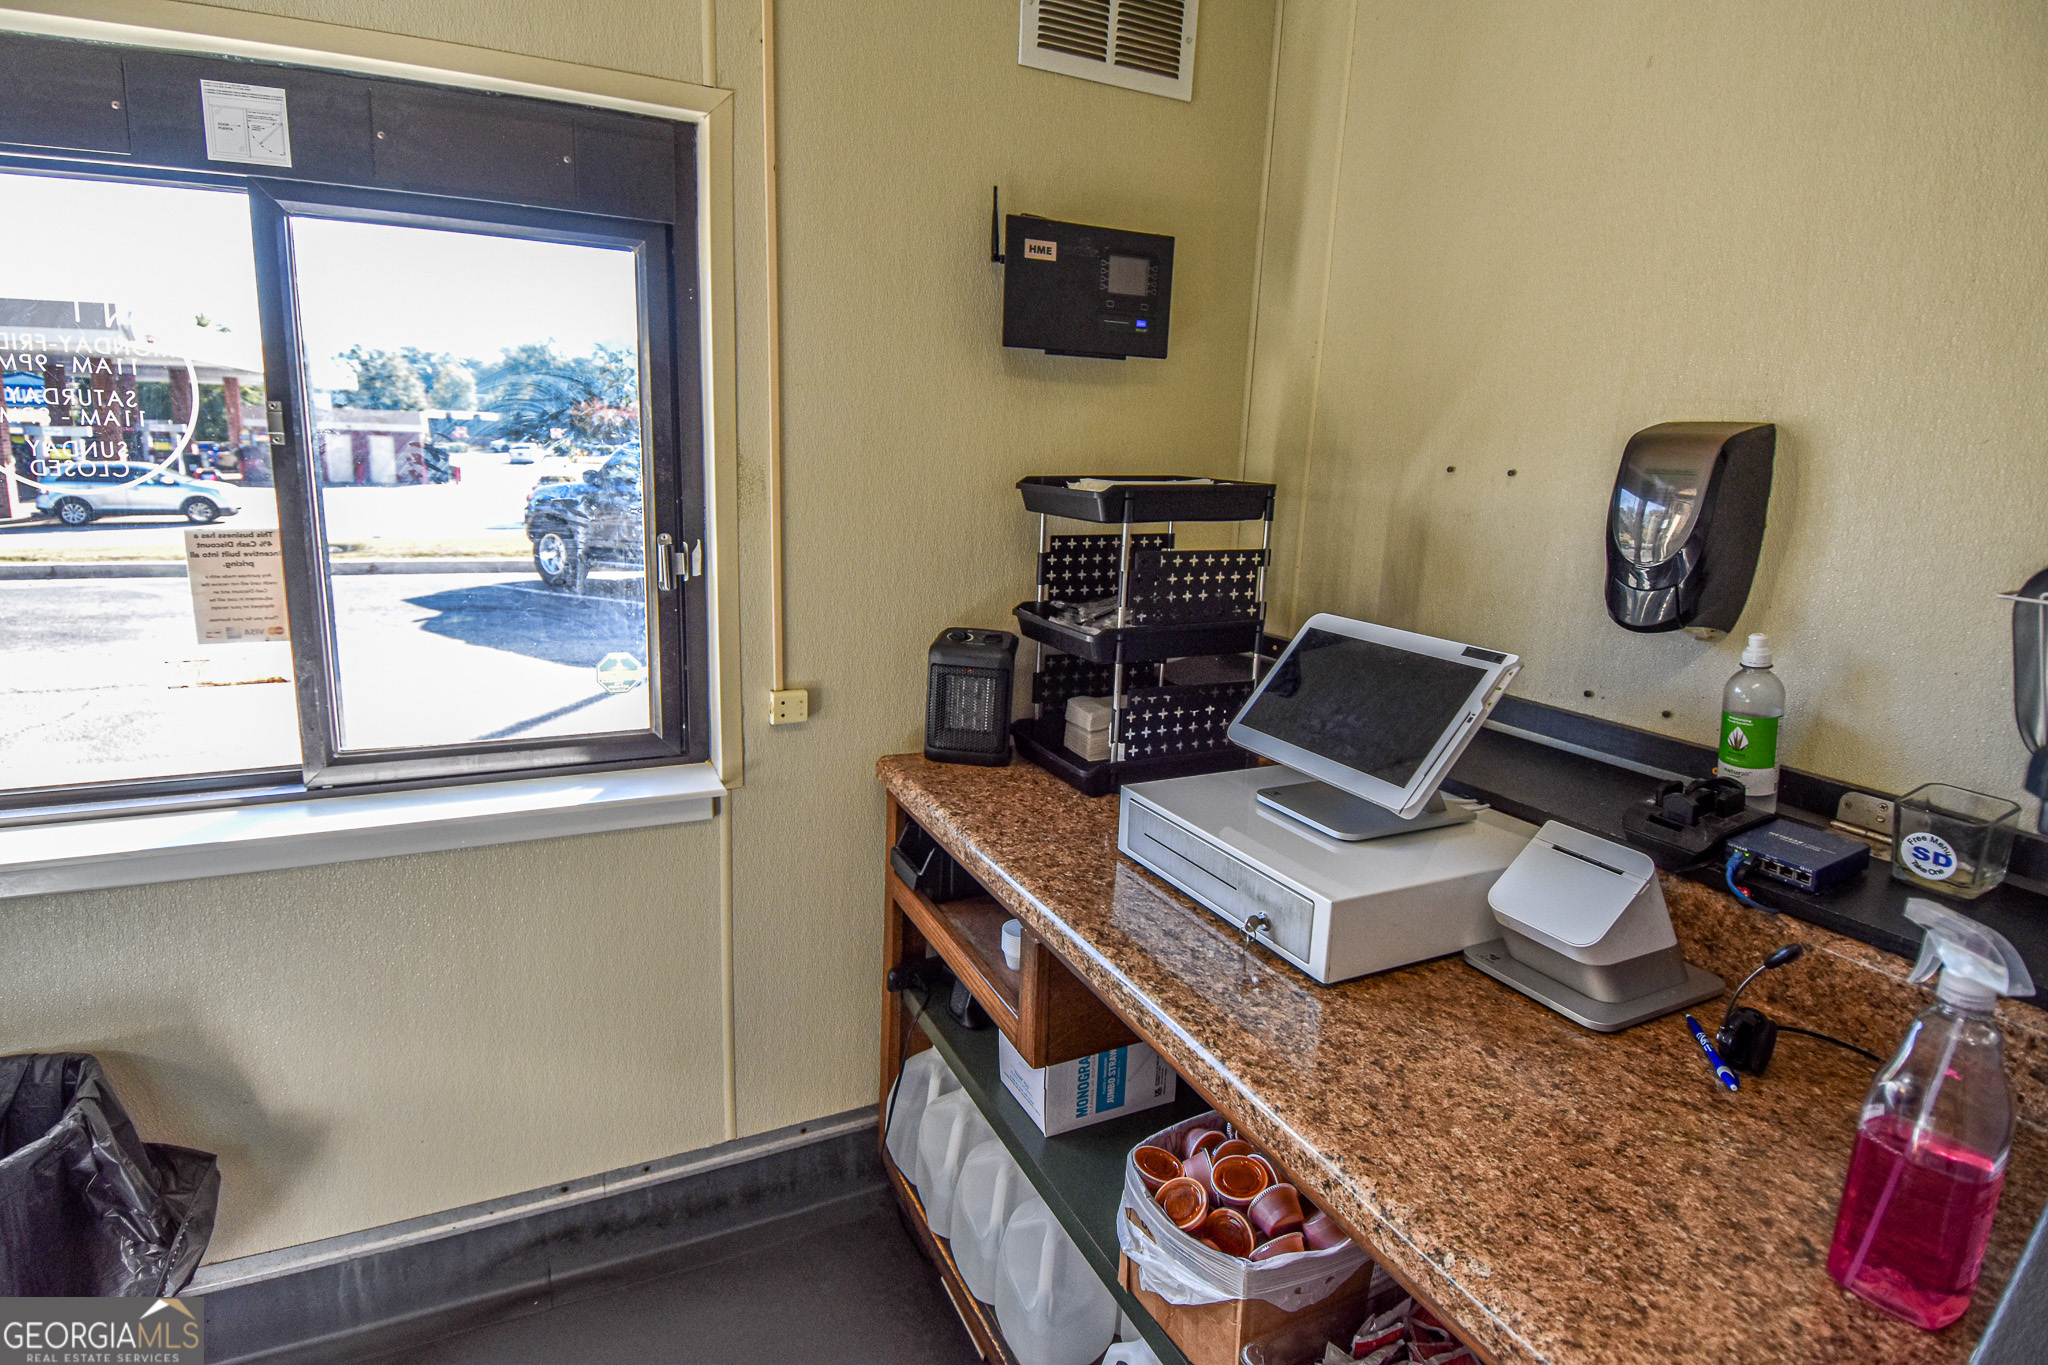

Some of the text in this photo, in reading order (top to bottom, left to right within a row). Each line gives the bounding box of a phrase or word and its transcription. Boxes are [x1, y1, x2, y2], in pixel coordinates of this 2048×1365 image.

[1029, 244, 1053, 255] HME
[1907, 836, 1952, 856] Free Menu
[1912, 846, 1952, 868] SD
[1912, 860, 1927, 873] Take
[1107, 1079, 1116, 1103] JUMBO
